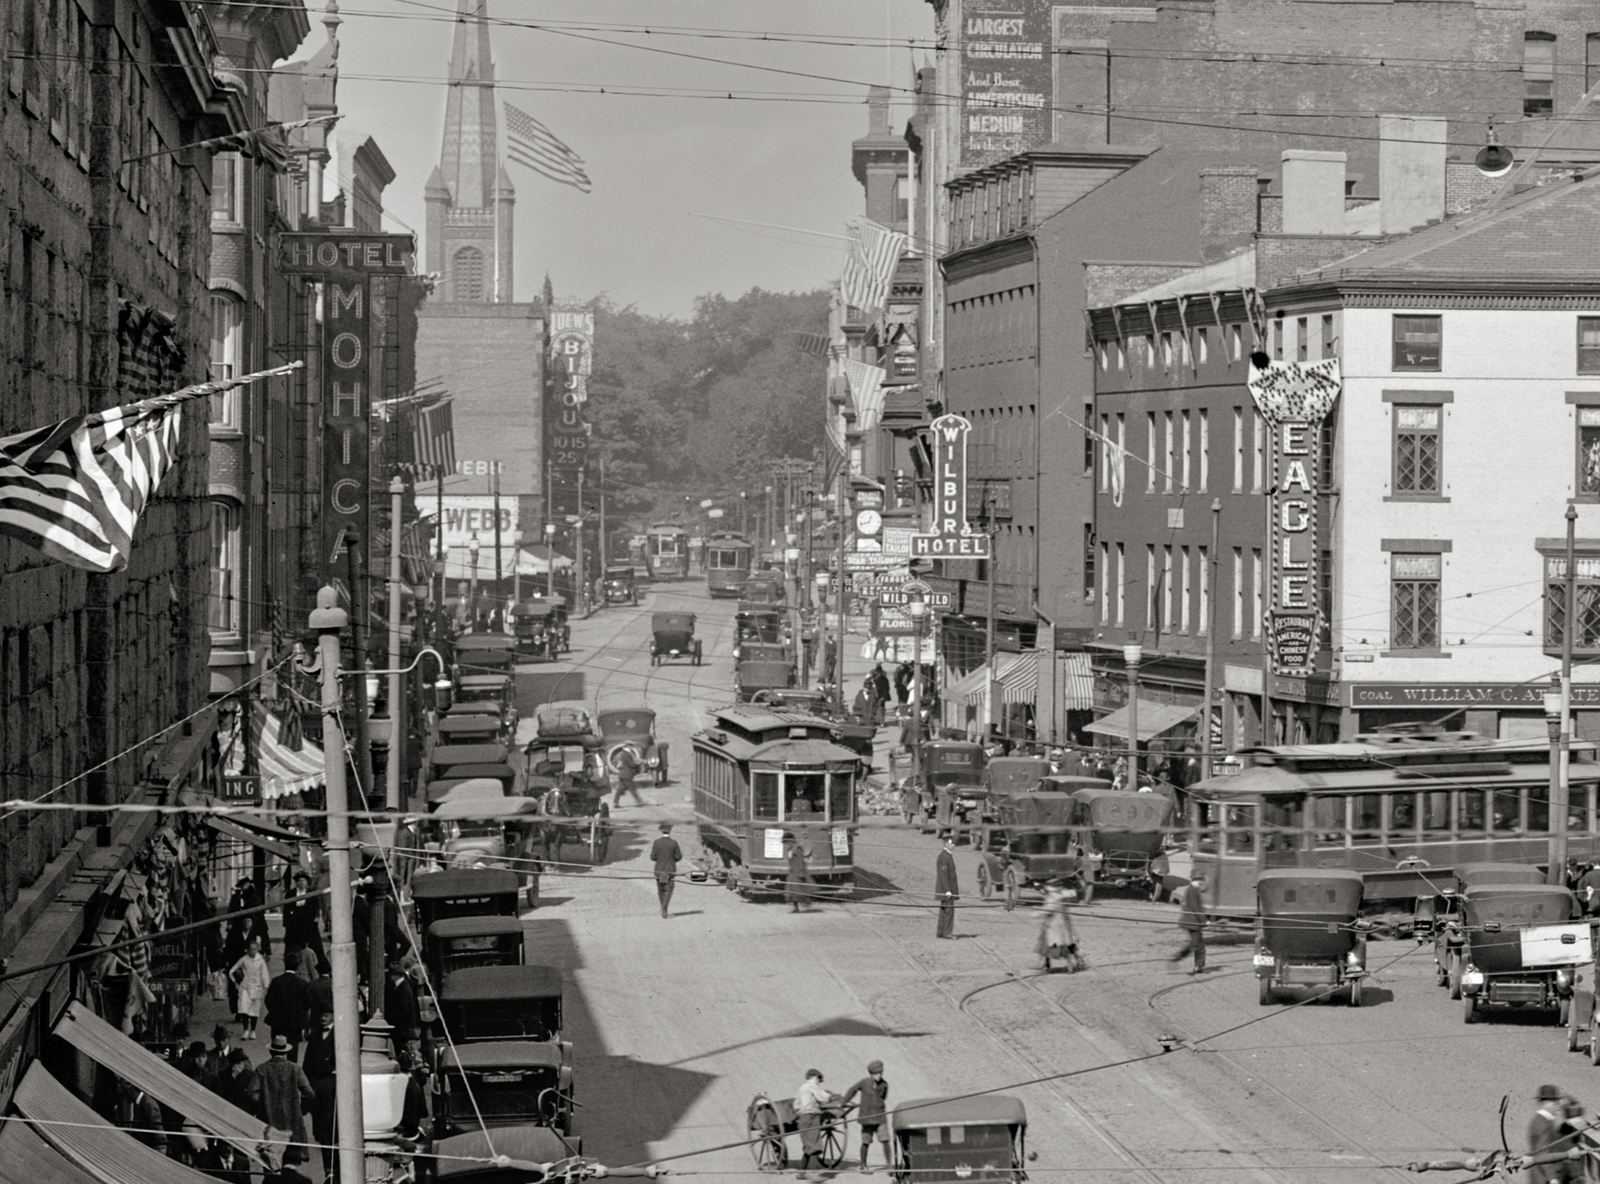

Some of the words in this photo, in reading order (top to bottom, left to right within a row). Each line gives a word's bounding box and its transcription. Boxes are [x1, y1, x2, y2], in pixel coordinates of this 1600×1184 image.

[967, 18, 1025, 36] LARGEST
[967, 42, 1043, 60] CIRCULATION
[967, 71, 992, 87] And
[966, 92, 1045, 110] ADVERTISING
[969, 115, 1024, 133] MEDIUM
[293, 242, 405, 267] HOTEL
[550, 312, 594, 336] LOEW'S
[563, 341, 580, 426] BIJOU
[942, 427, 960, 534] WILBUR
[445, 508, 512, 533] WEBB
[1282, 422, 1311, 608] EAGLE
[917, 538, 985, 554] HOTEL
[882, 593, 908, 604] WILD
[923, 595, 948, 605] WILD
[1274, 617, 1315, 632] RESTAURANT
[1277, 632, 1311, 643] AMERICAN
[1279, 646, 1308, 654] CHINESE
[1284, 655, 1304, 663] FOOD
[1359, 691, 1393, 701] COAL
[1404, 688, 1493, 702] WILLIAM
[1501, 688, 1518, 702] C.
[225, 781, 254, 796] ING
